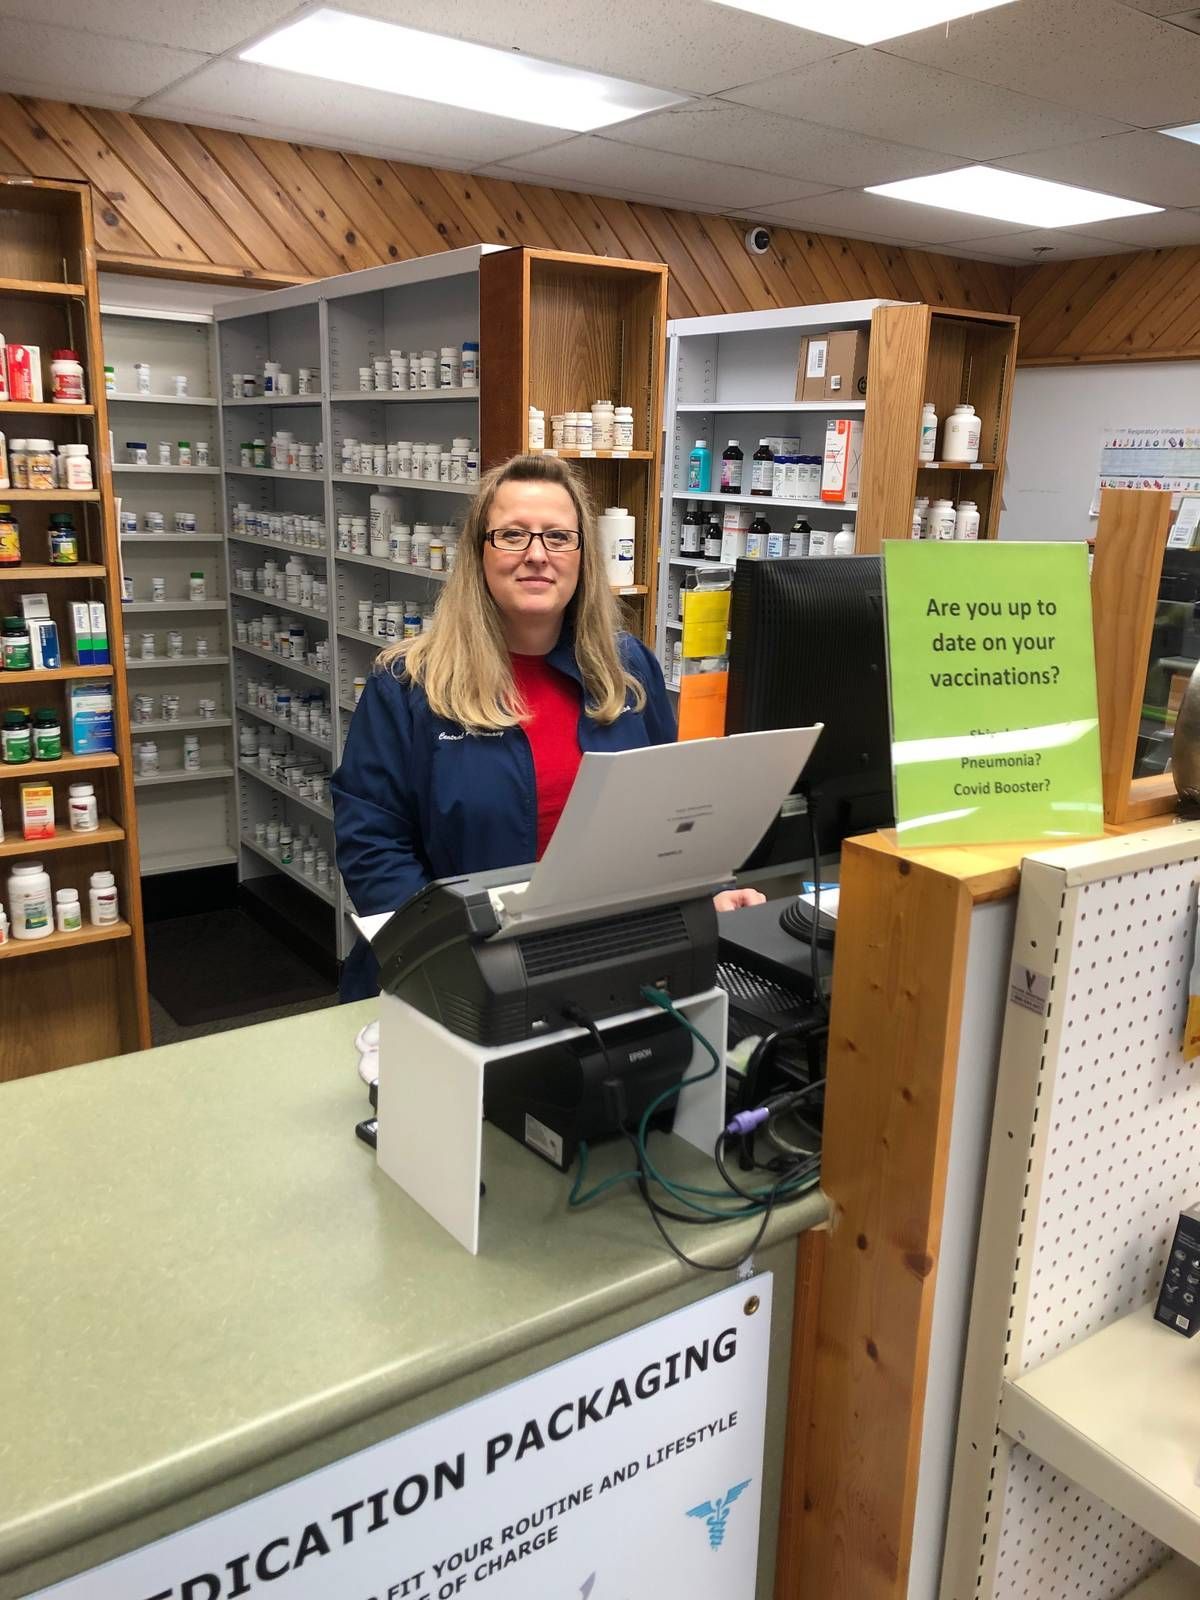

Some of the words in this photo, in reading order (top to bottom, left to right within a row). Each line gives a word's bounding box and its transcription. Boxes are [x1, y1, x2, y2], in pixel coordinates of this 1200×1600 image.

[926, 599, 961, 617] Are
[966, 602, 1002, 621] you
[1008, 602, 1032, 621] up
[1036, 599, 1057, 617] to
[932, 632, 978, 652] date
[982, 637, 1007, 652] on
[1012, 636, 1056, 655] your
[930, 665, 1060, 688] vaccinations?
[961, 752, 1042, 769] Pneumonia?
[953, 781, 991, 796] Covid
[994, 778, 1051, 795] Booster?
[629, 1048, 652, 1062] EPSON
[145, 1452, 465, 1600] DICATION
[486, 1327, 737, 1475] PACKAGING
[387, 1571, 426, 1600] FIT
[432, 1536, 494, 1579] YOUR
[501, 1484, 593, 1544] ROUTINE
[599, 1461, 640, 1494] AND
[646, 1411, 737, 1469] LIFESTYLE
[438, 1573, 468, 1600] OF
[474, 1525, 558, 1582] CHARGE
